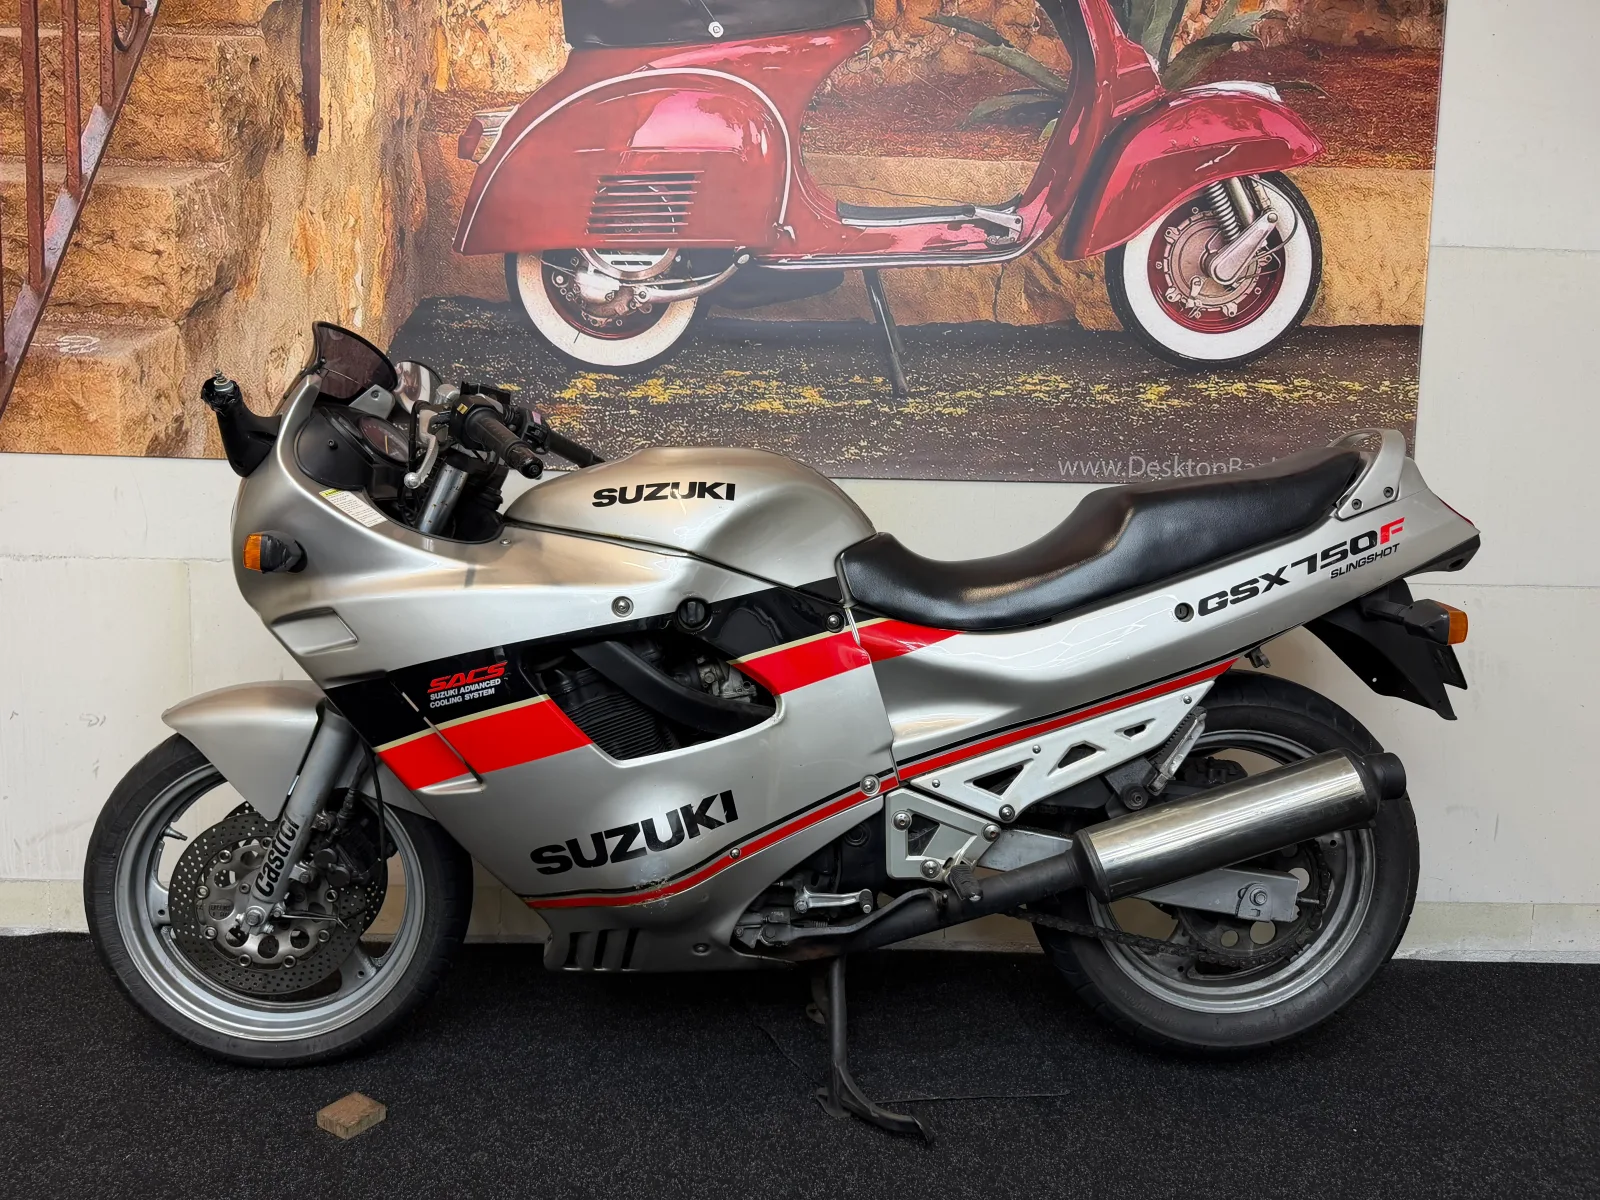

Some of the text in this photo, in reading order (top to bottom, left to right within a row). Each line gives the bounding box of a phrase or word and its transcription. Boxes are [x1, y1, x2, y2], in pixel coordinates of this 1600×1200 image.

[592, 481, 736, 507] SUZUKI
[1330, 543, 1400, 579] SLINGSHOT
[427, 661, 508, 693] SACS
[430, 678, 501, 701] SUZUKI ADVANCED
[430, 687, 495, 708] COOLING SYSTEM
[530, 789, 739, 875] SUZUKI
